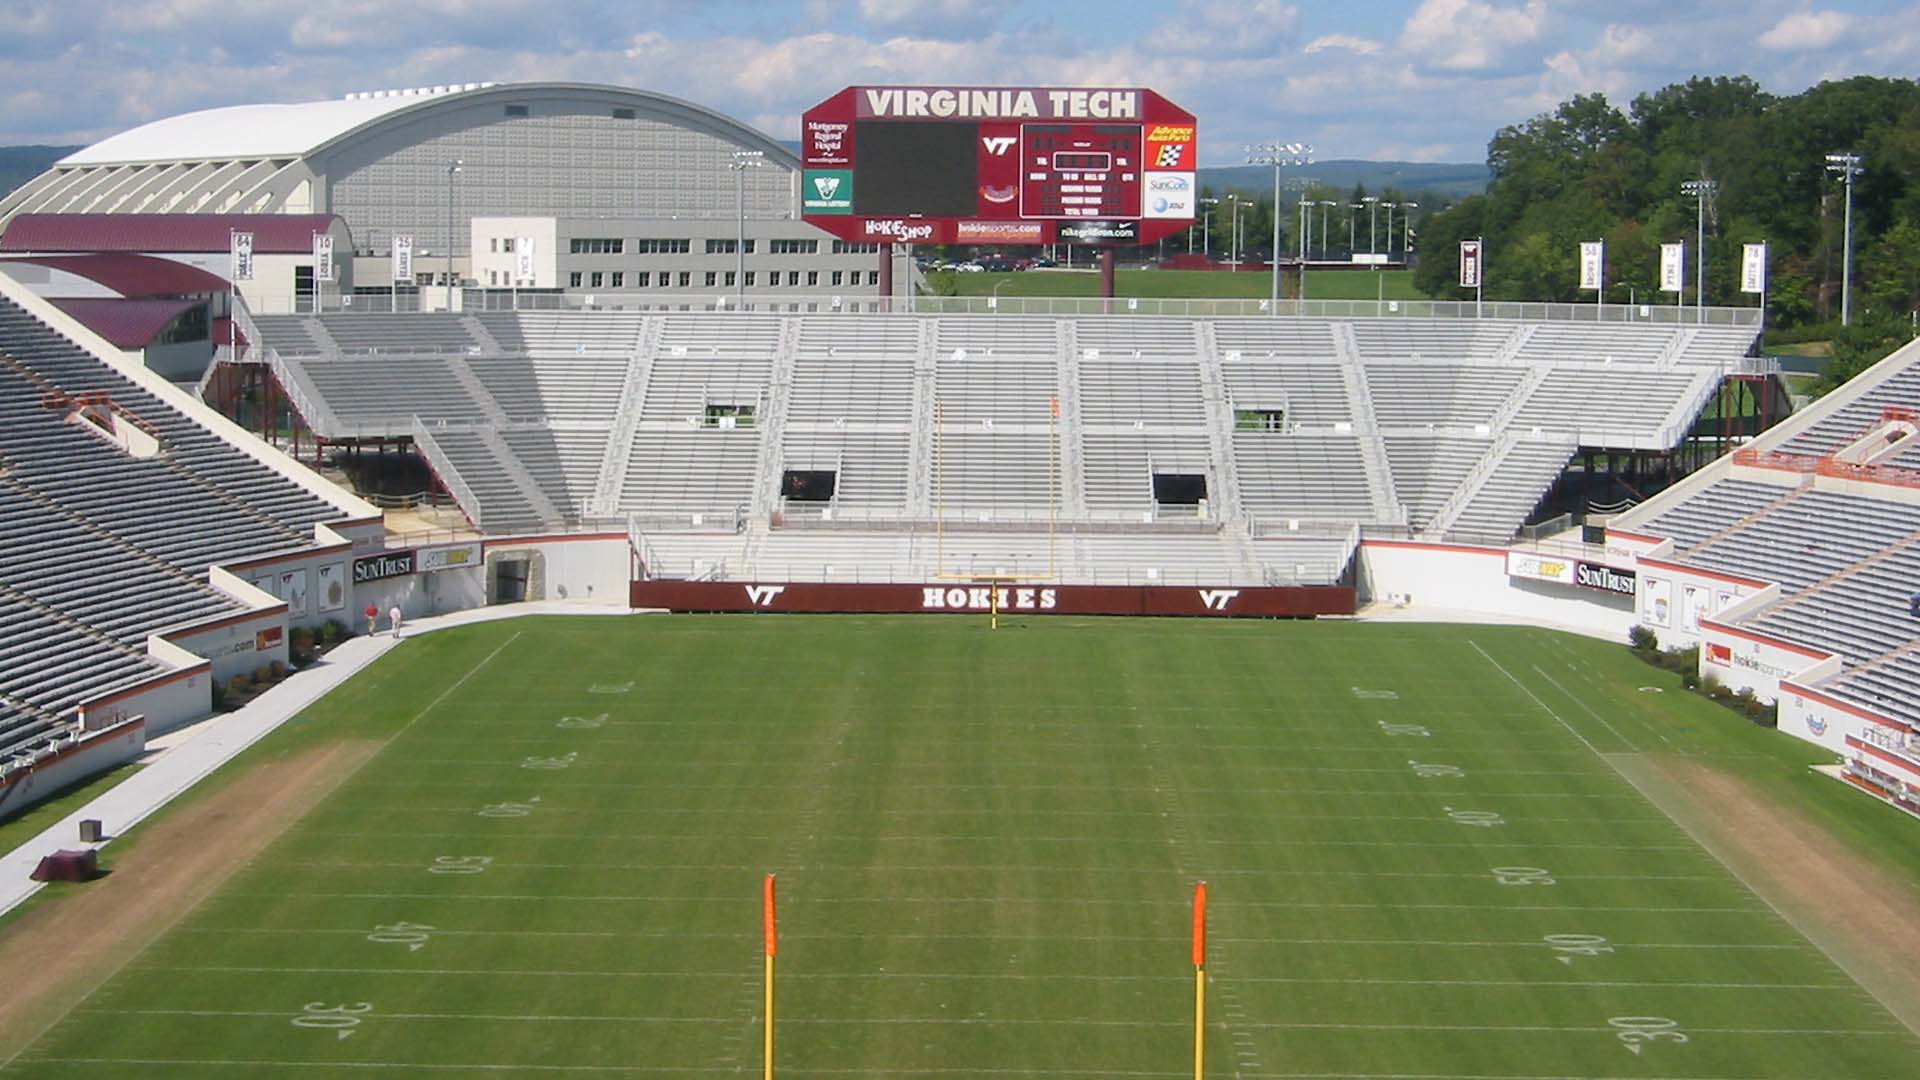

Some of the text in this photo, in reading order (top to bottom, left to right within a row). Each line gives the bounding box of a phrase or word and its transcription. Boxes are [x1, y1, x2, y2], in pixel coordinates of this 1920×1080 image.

[866, 90, 1136, 118] VIRGINIA TECH
[982, 137, 1017, 155] VT
[744, 585, 785, 606] VT
[922, 587, 1057, 609] HOKIES
[1198, 589, 1240, 610] VT
[428, 856, 494, 874] 50
[1491, 866, 1557, 886] 50
[367, 921, 436, 943] 40
[1544, 934, 1615, 956] 40
[290, 1002, 373, 1028] 30
[1607, 1016, 1688, 1043] 30
